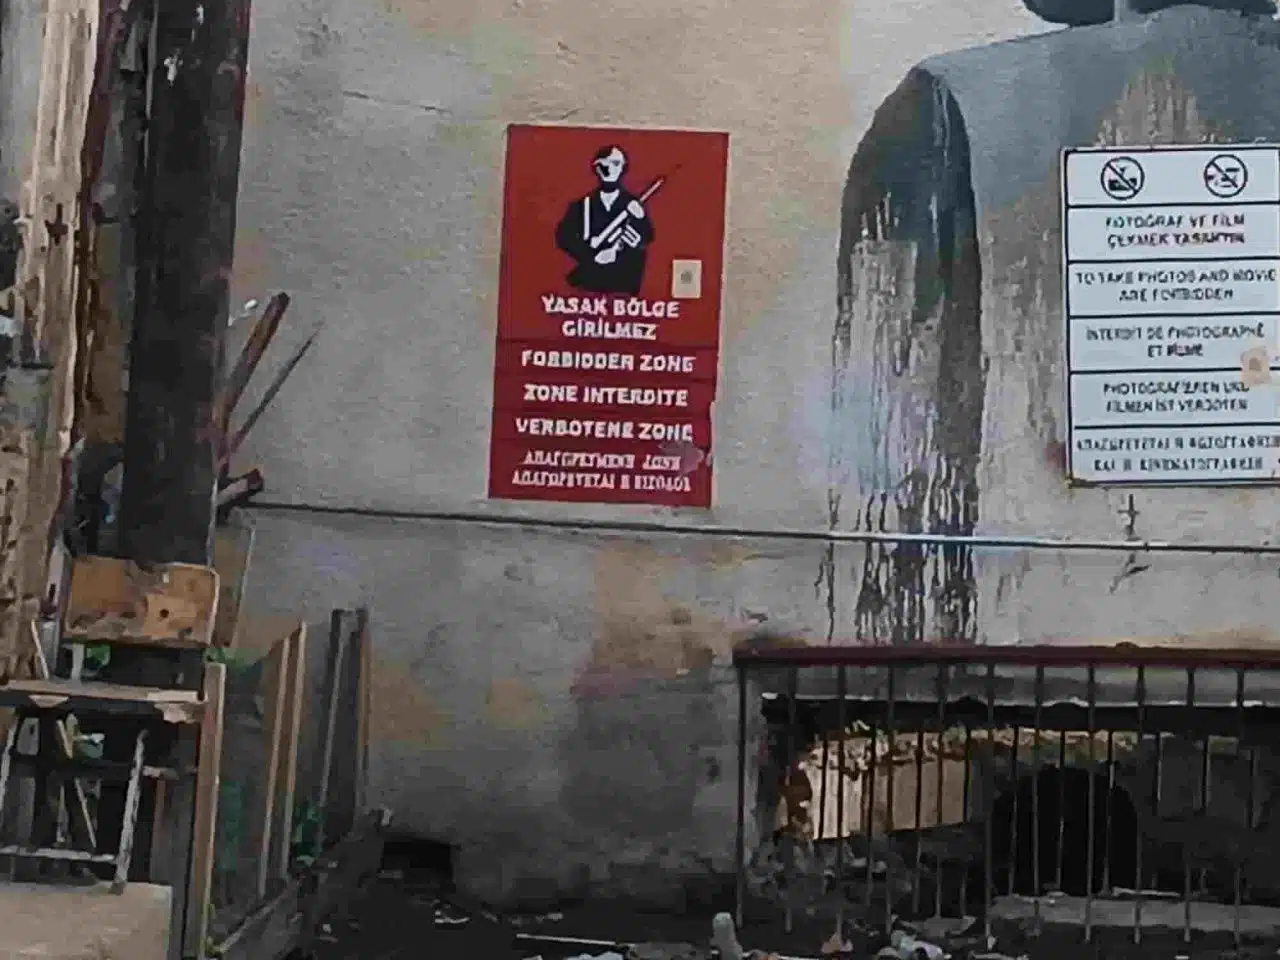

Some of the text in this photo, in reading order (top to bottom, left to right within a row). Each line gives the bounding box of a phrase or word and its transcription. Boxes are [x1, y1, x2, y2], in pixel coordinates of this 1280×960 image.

[1075, 272, 1096, 286] TO
[1100, 271, 1134, 285] TAKE
[1138, 270, 1195, 284] PHOTOS
[1200, 269, 1229, 282] AND
[541, 294, 681, 318] YASAK BÖLGE
[1119, 289, 1148, 303] ARE
[562, 318, 659, 340] GİRİLMEZ
[521, 349, 697, 373] FORBIDDEN ZONE
[523, 383, 688, 406] ZONE INTERDITE
[515, 417, 693, 440] VERBOTENE ZONE
